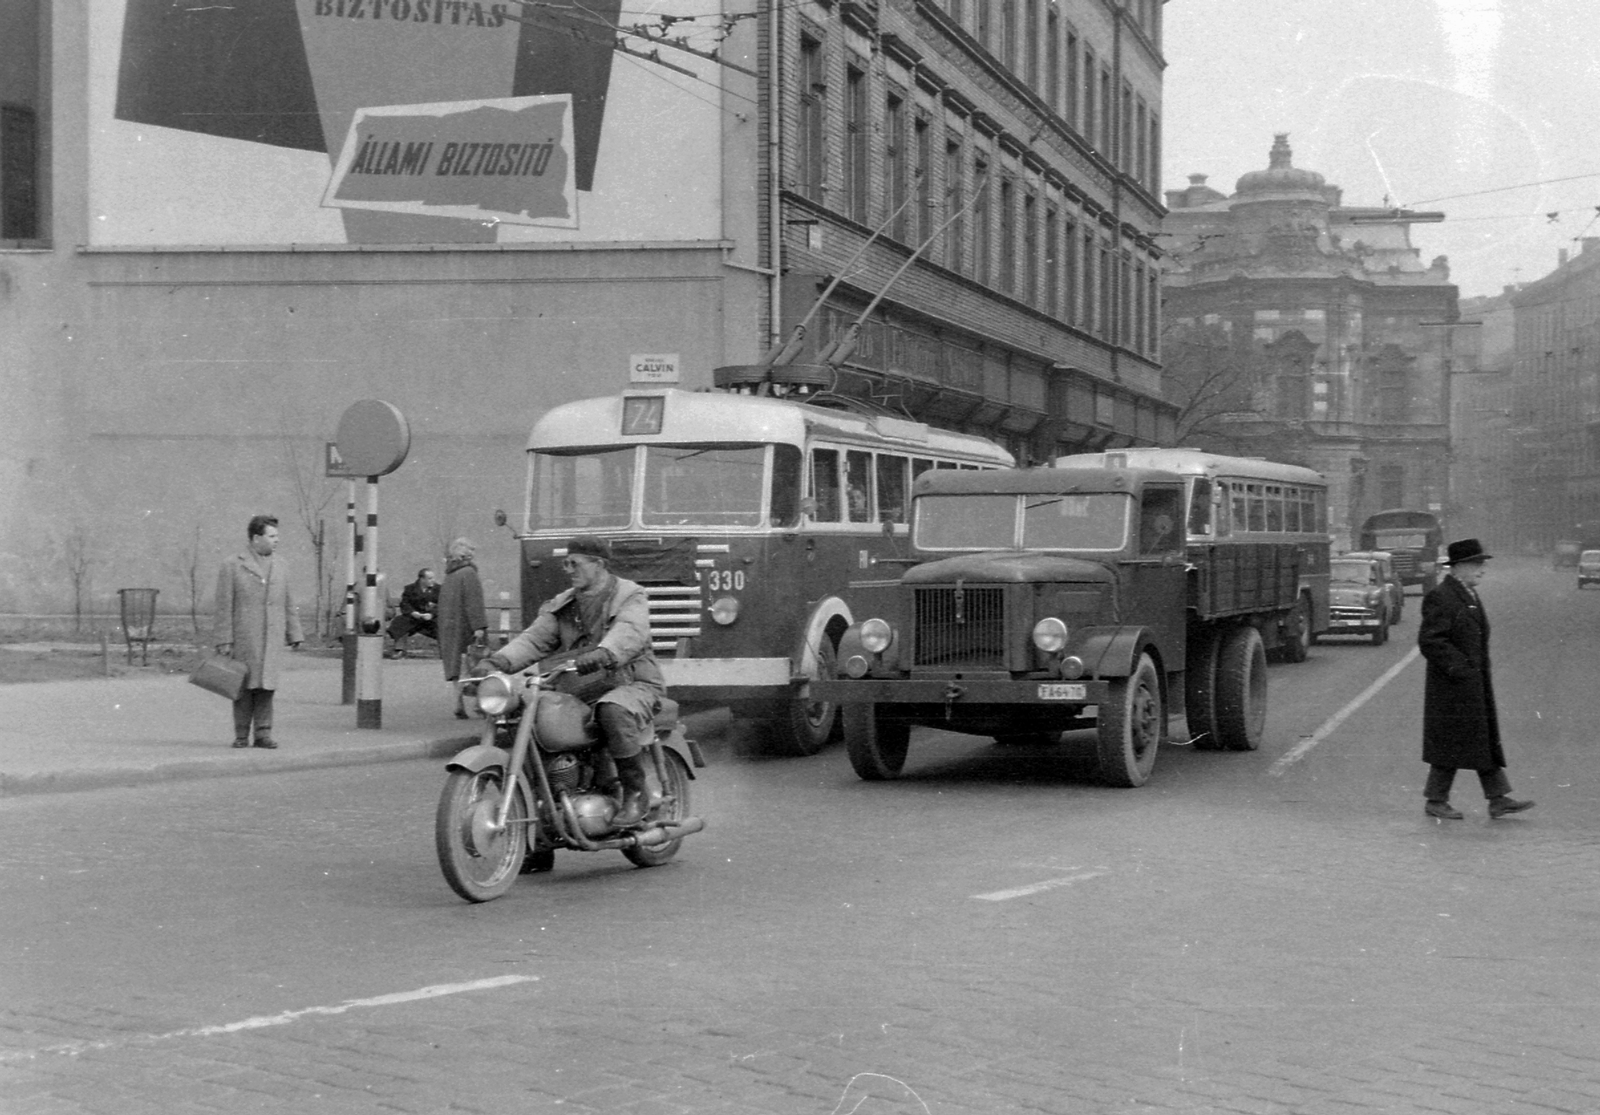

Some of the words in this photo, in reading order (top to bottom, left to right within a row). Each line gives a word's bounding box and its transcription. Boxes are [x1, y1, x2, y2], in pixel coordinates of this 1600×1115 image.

[351, 134, 434, 176] ÁLLAMI
[435, 138, 554, 176] BIZTOSITÓ
[635, 363, 674, 373] CALVIN
[632, 404, 656, 429] 74
[709, 570, 745, 591] 330
